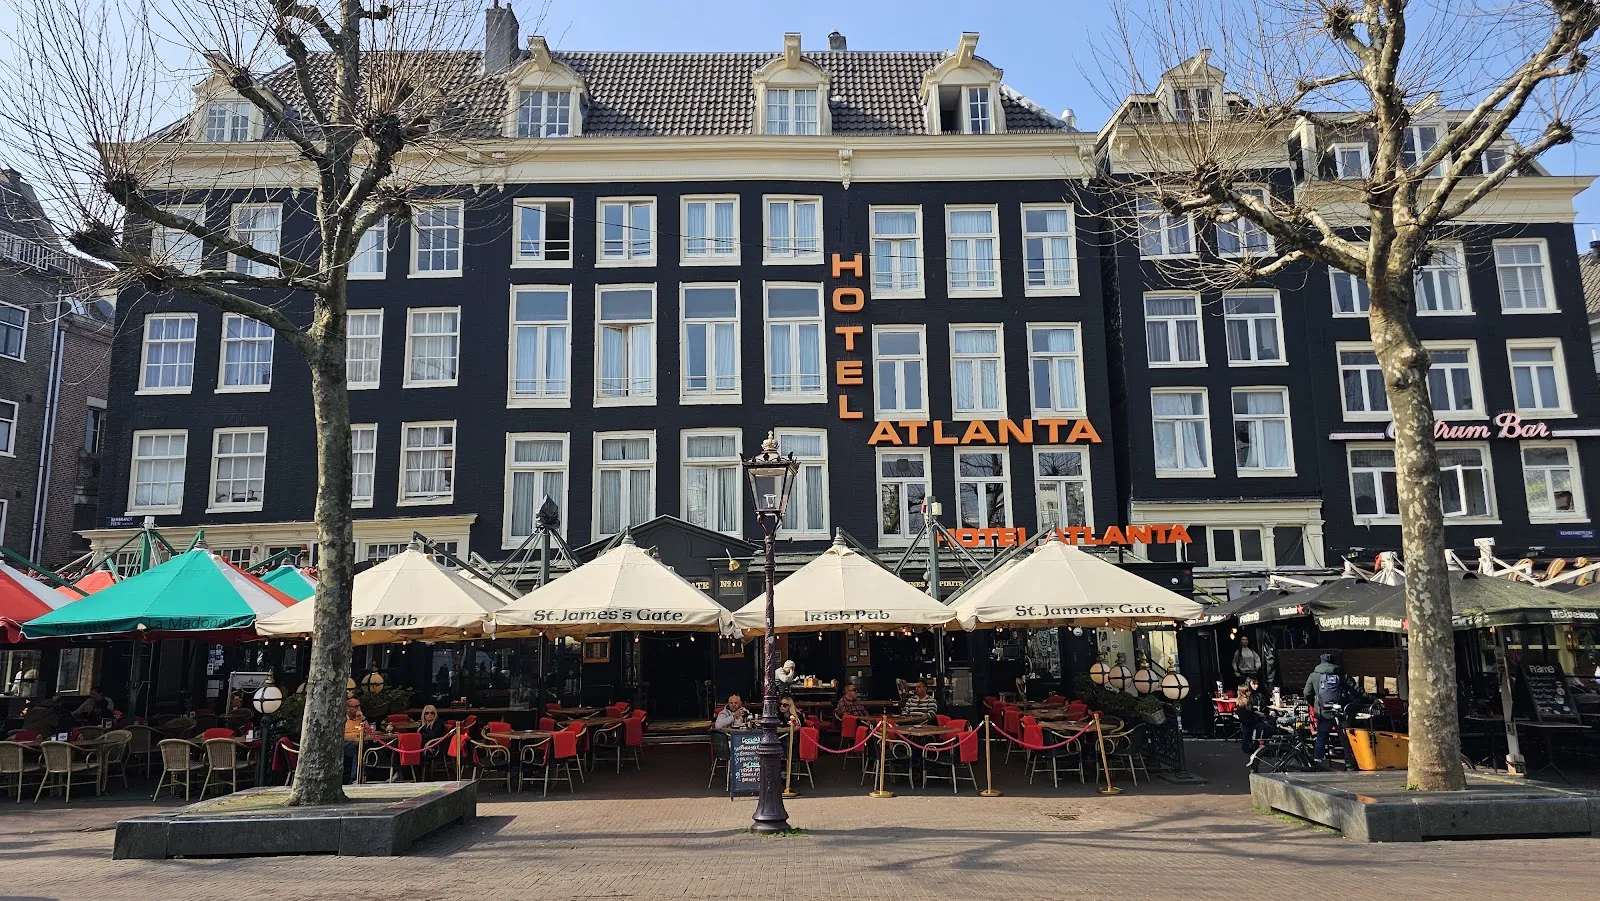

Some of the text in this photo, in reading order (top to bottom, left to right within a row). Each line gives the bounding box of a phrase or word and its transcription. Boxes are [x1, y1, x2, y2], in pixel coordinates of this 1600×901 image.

[831, 252, 865, 420] HOTEL
[867, 418, 1103, 446] ATLANTA
[1385, 411, 1550, 440] Ctrum Bar
[732, 580, 743, 588] 10
[636, 608, 684, 622] Gate
[855, 609, 890, 621] Pub
[1118, 603, 1166, 615] Gate
[1549, 610, 1599, 621] Heineken
[147, 615, 245, 629] La Madonnin
[350, 613, 418, 628] ish Pub
[1318, 615, 1371, 628] Burgers & Beers
[55, 622, 112, 635] Pizzeria
